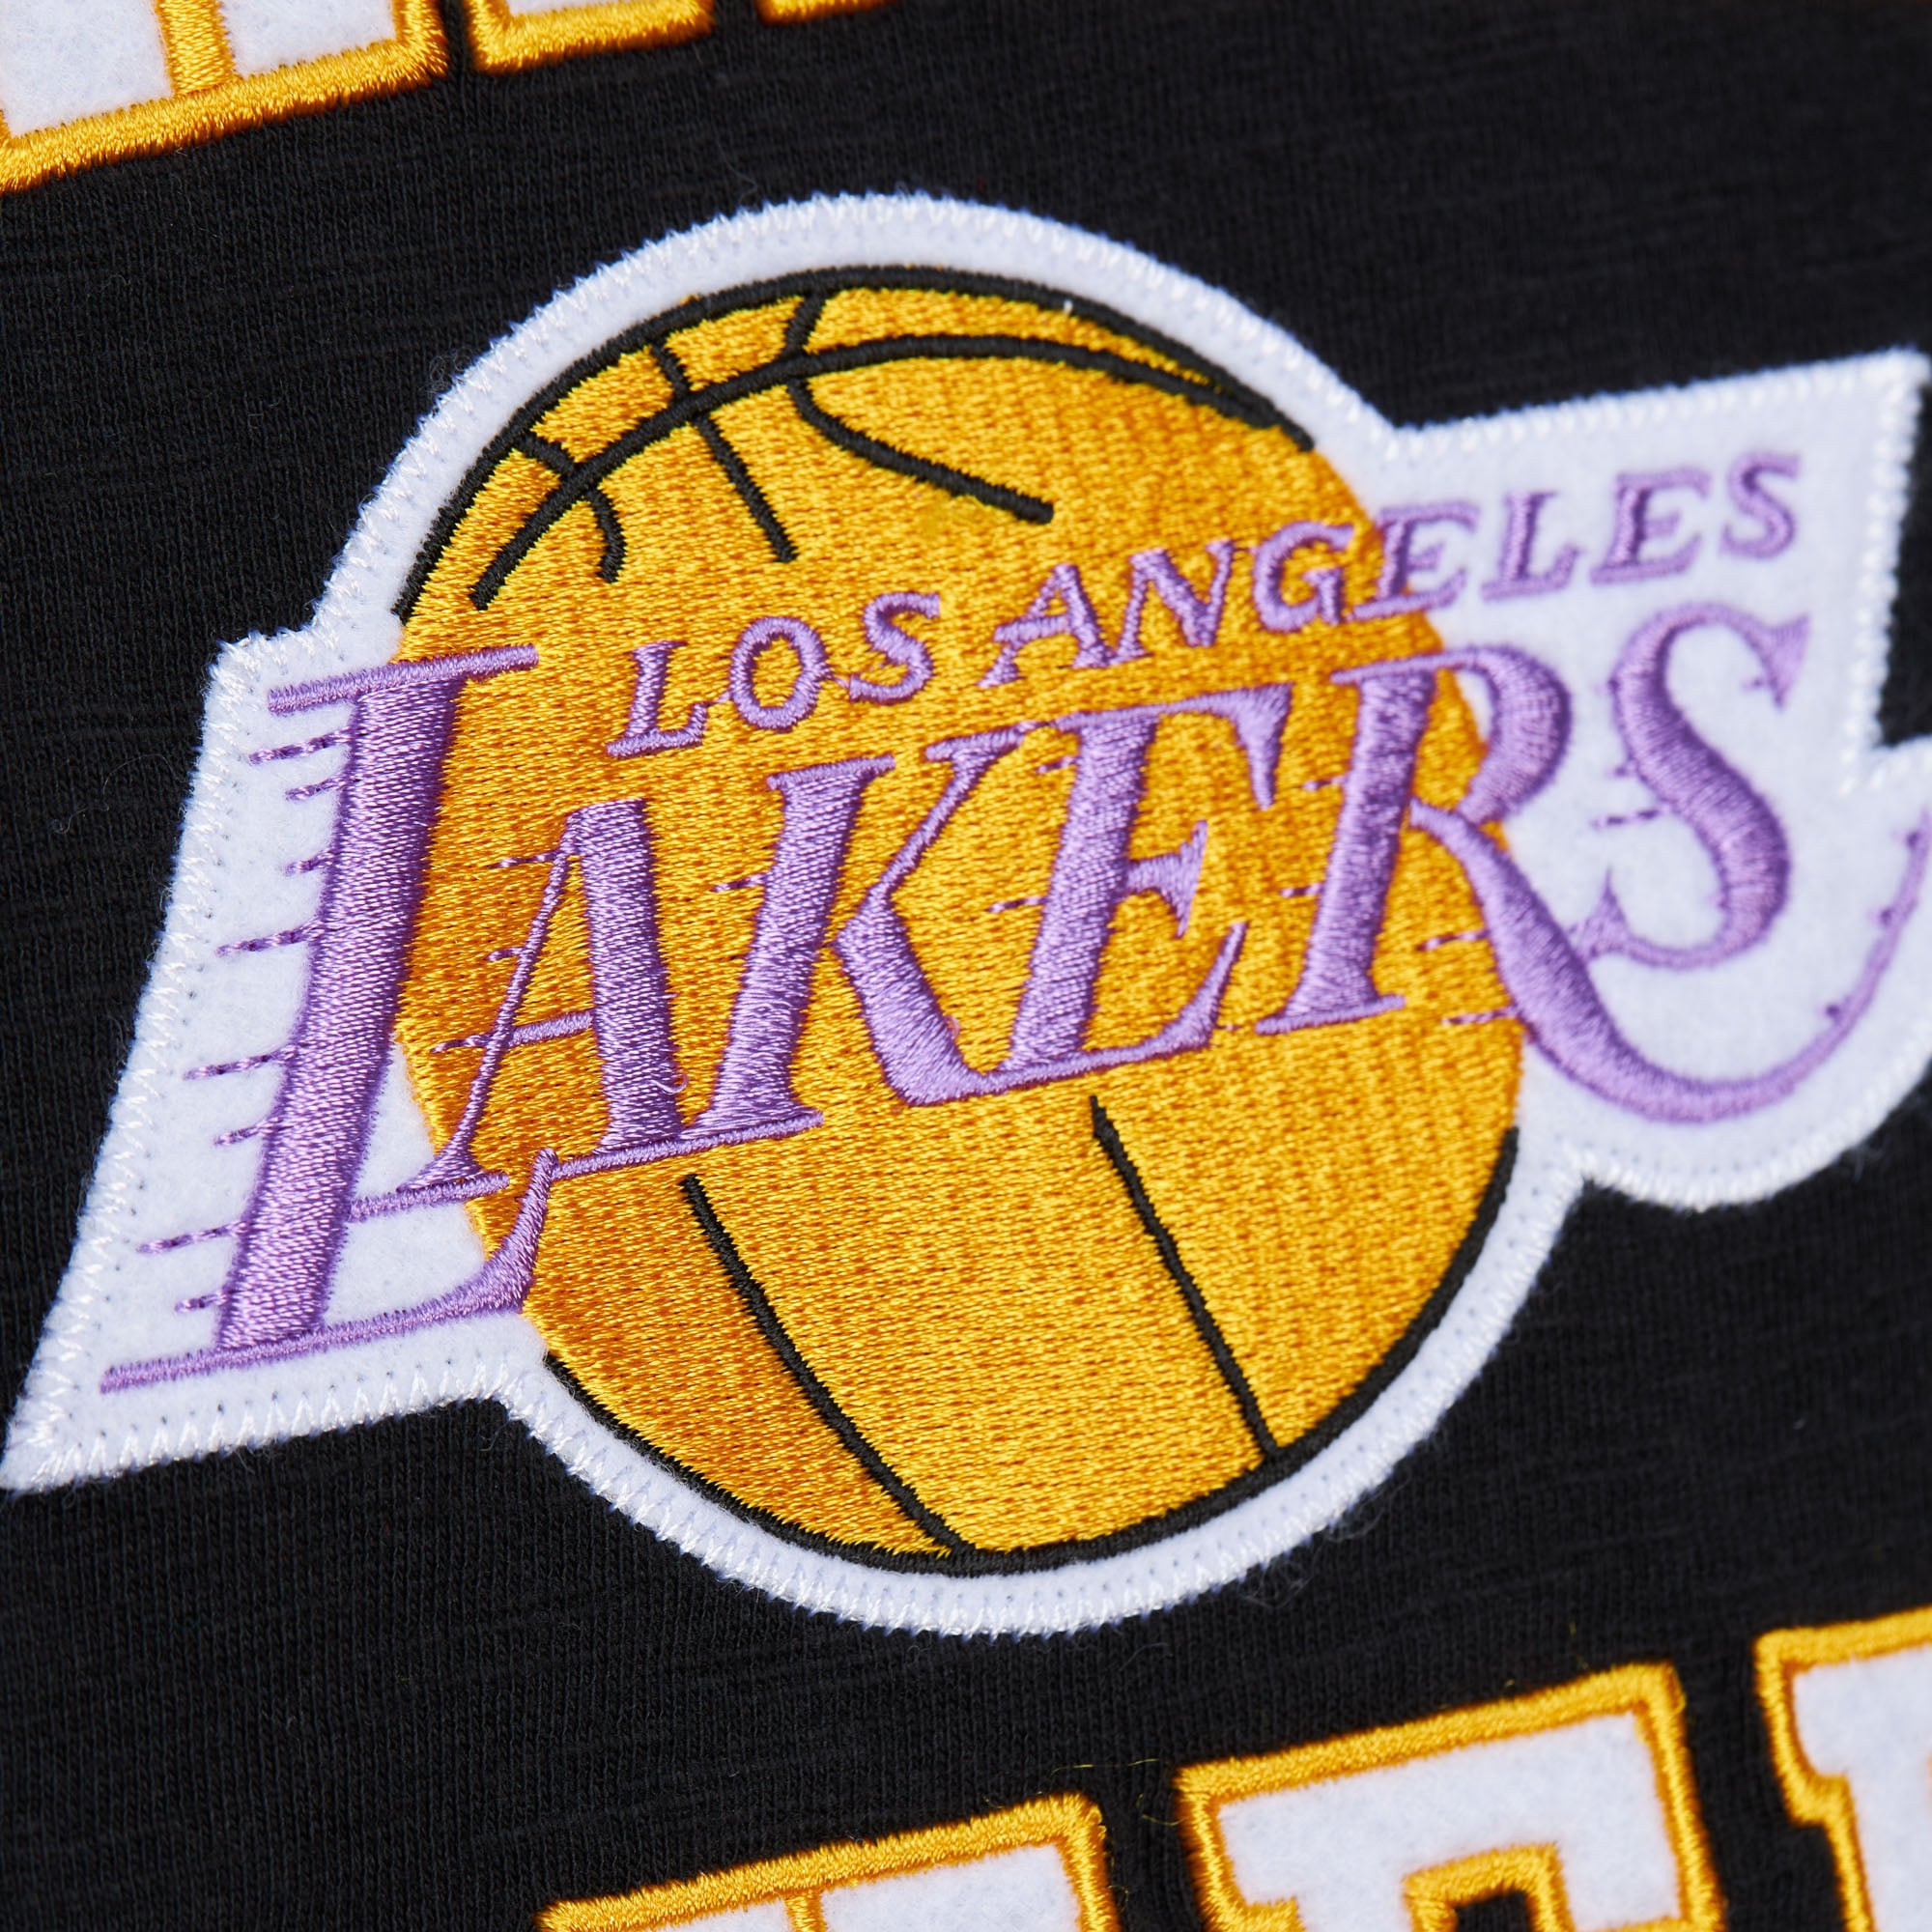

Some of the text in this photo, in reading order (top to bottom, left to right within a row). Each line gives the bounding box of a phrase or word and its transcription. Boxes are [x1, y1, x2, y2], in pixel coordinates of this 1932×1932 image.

[607, 450, 1802, 758] LOS ANGELES
[100, 603, 1932, 1393] LAKERS
